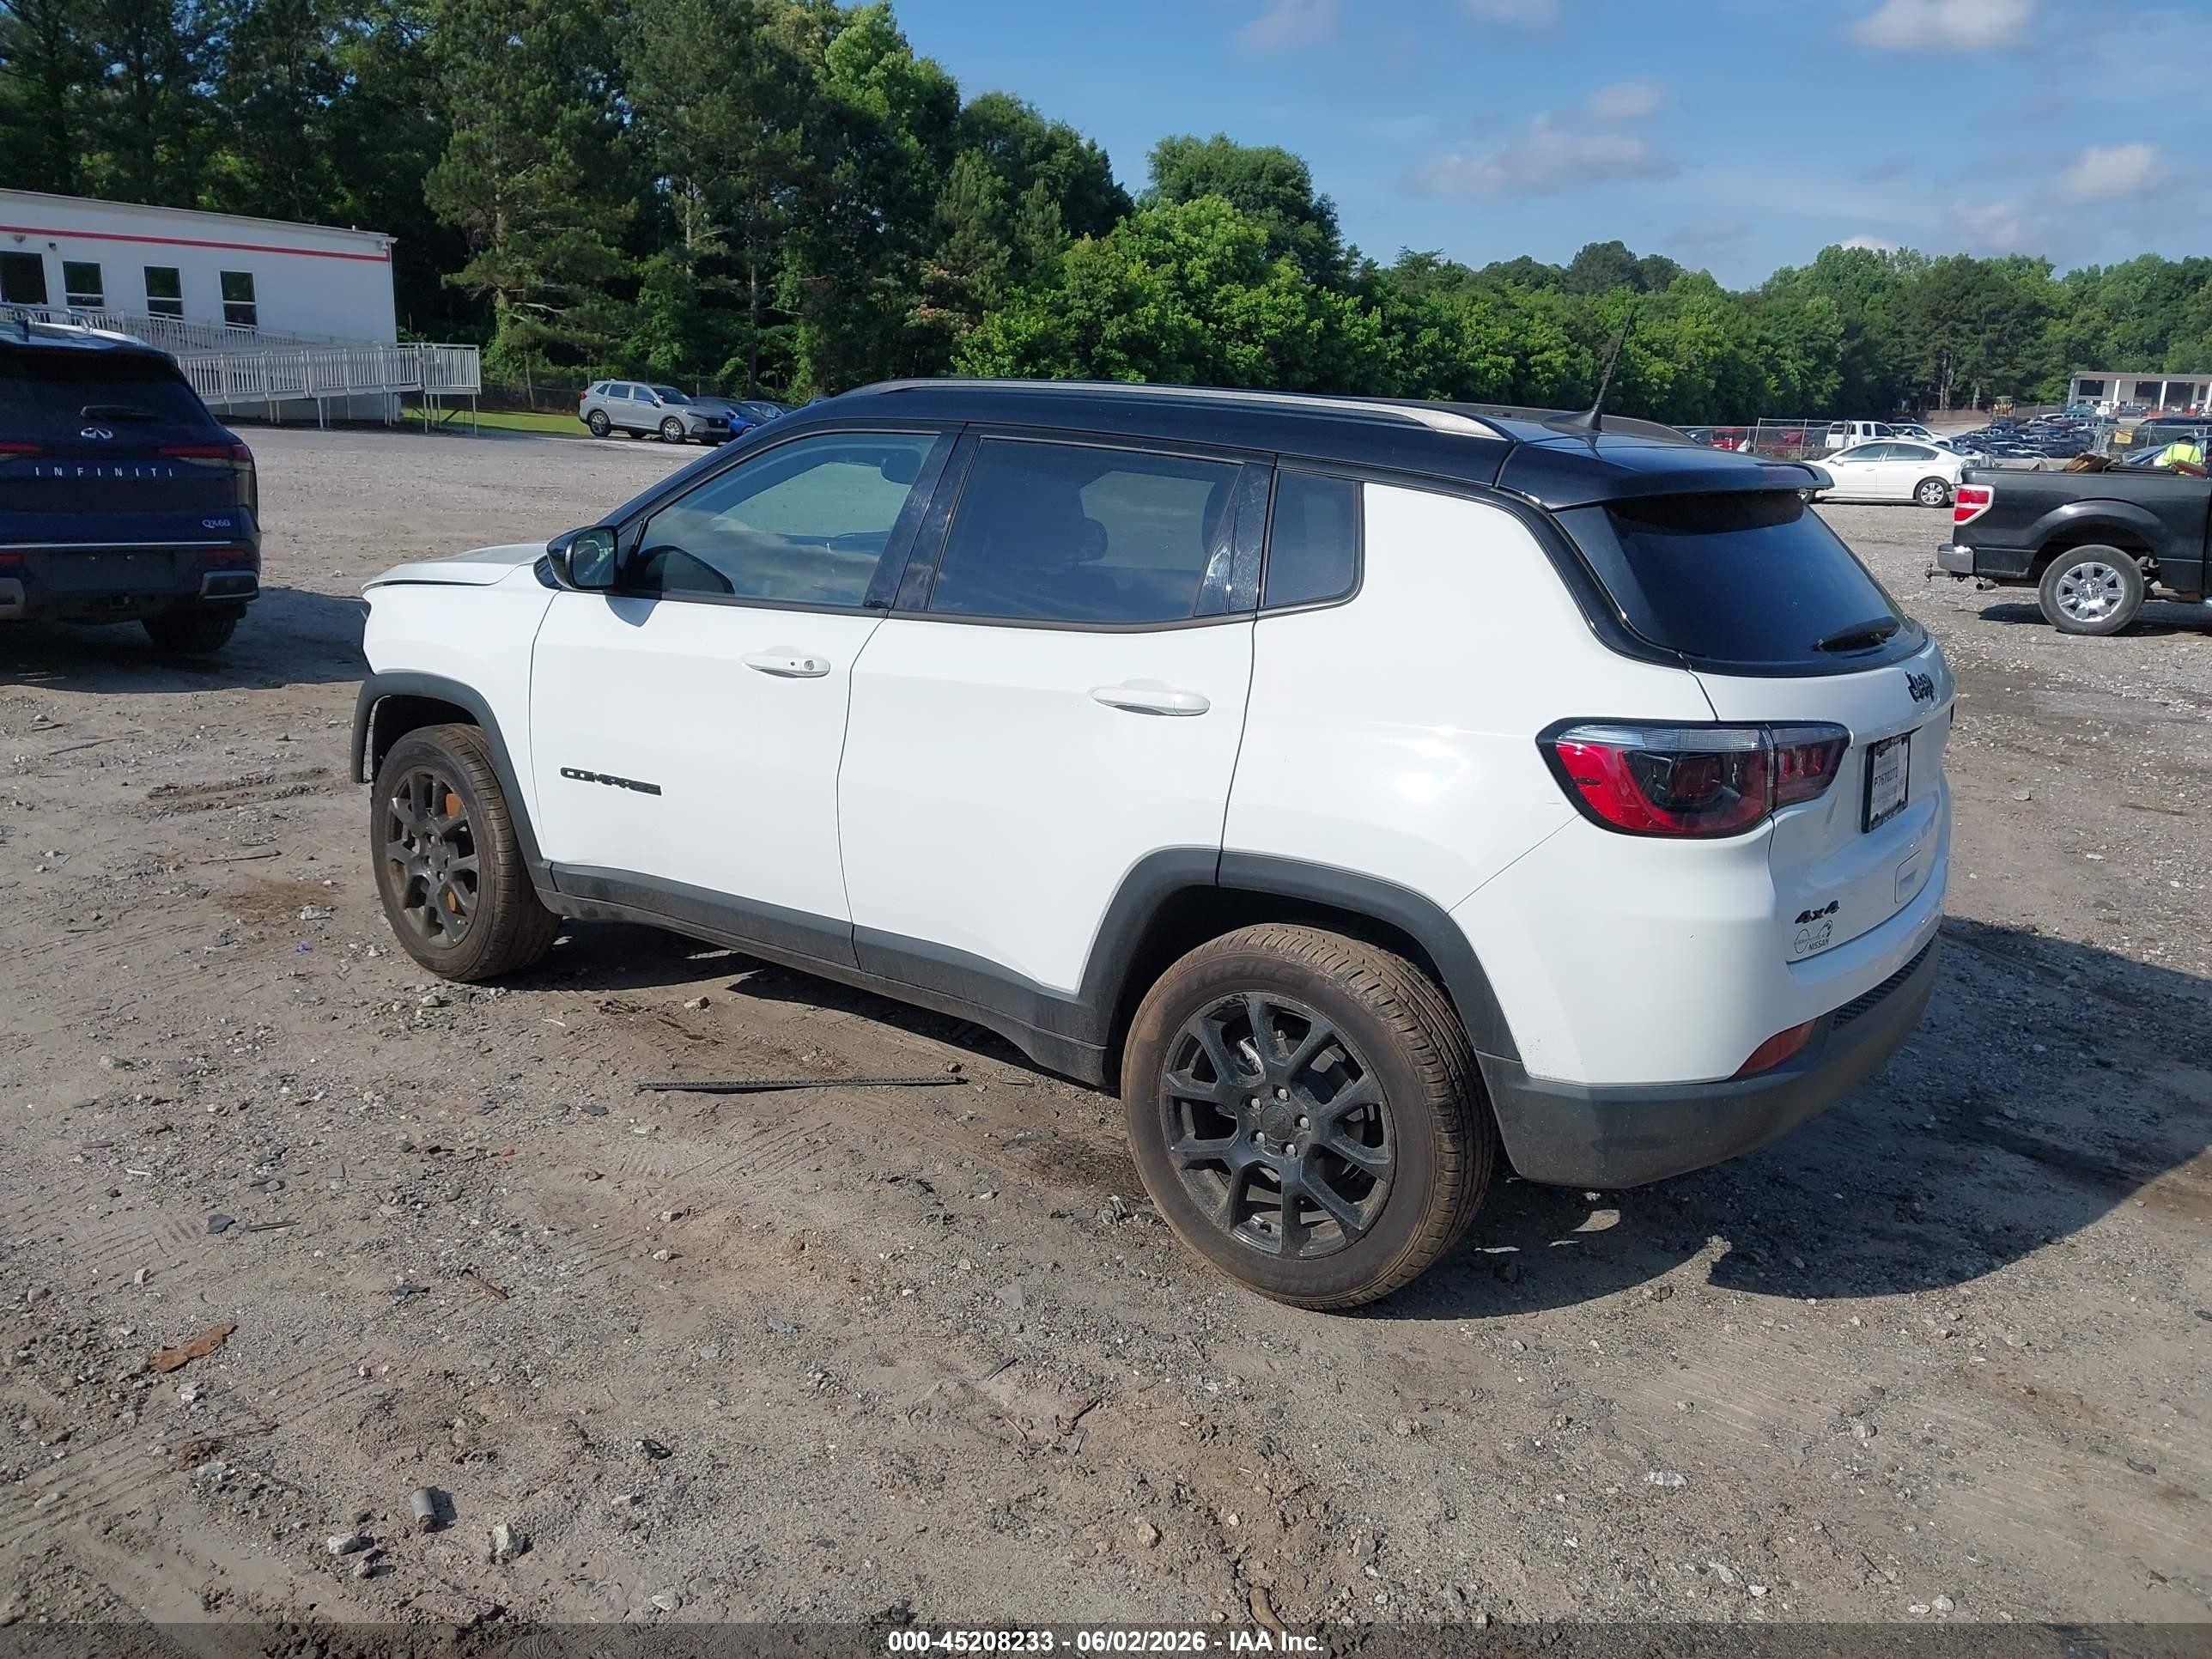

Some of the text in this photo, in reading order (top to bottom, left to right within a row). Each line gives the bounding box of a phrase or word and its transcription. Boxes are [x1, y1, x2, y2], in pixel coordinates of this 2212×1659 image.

[34, 466, 173, 477] INFINITI
[201, 519, 231, 529] QX60
[1904, 671, 1935, 703] Jeep
[560, 767, 661, 796] COMPASS
[1794, 899, 1841, 925] 4x4
[1808, 937, 1830, 951] NISSAN
